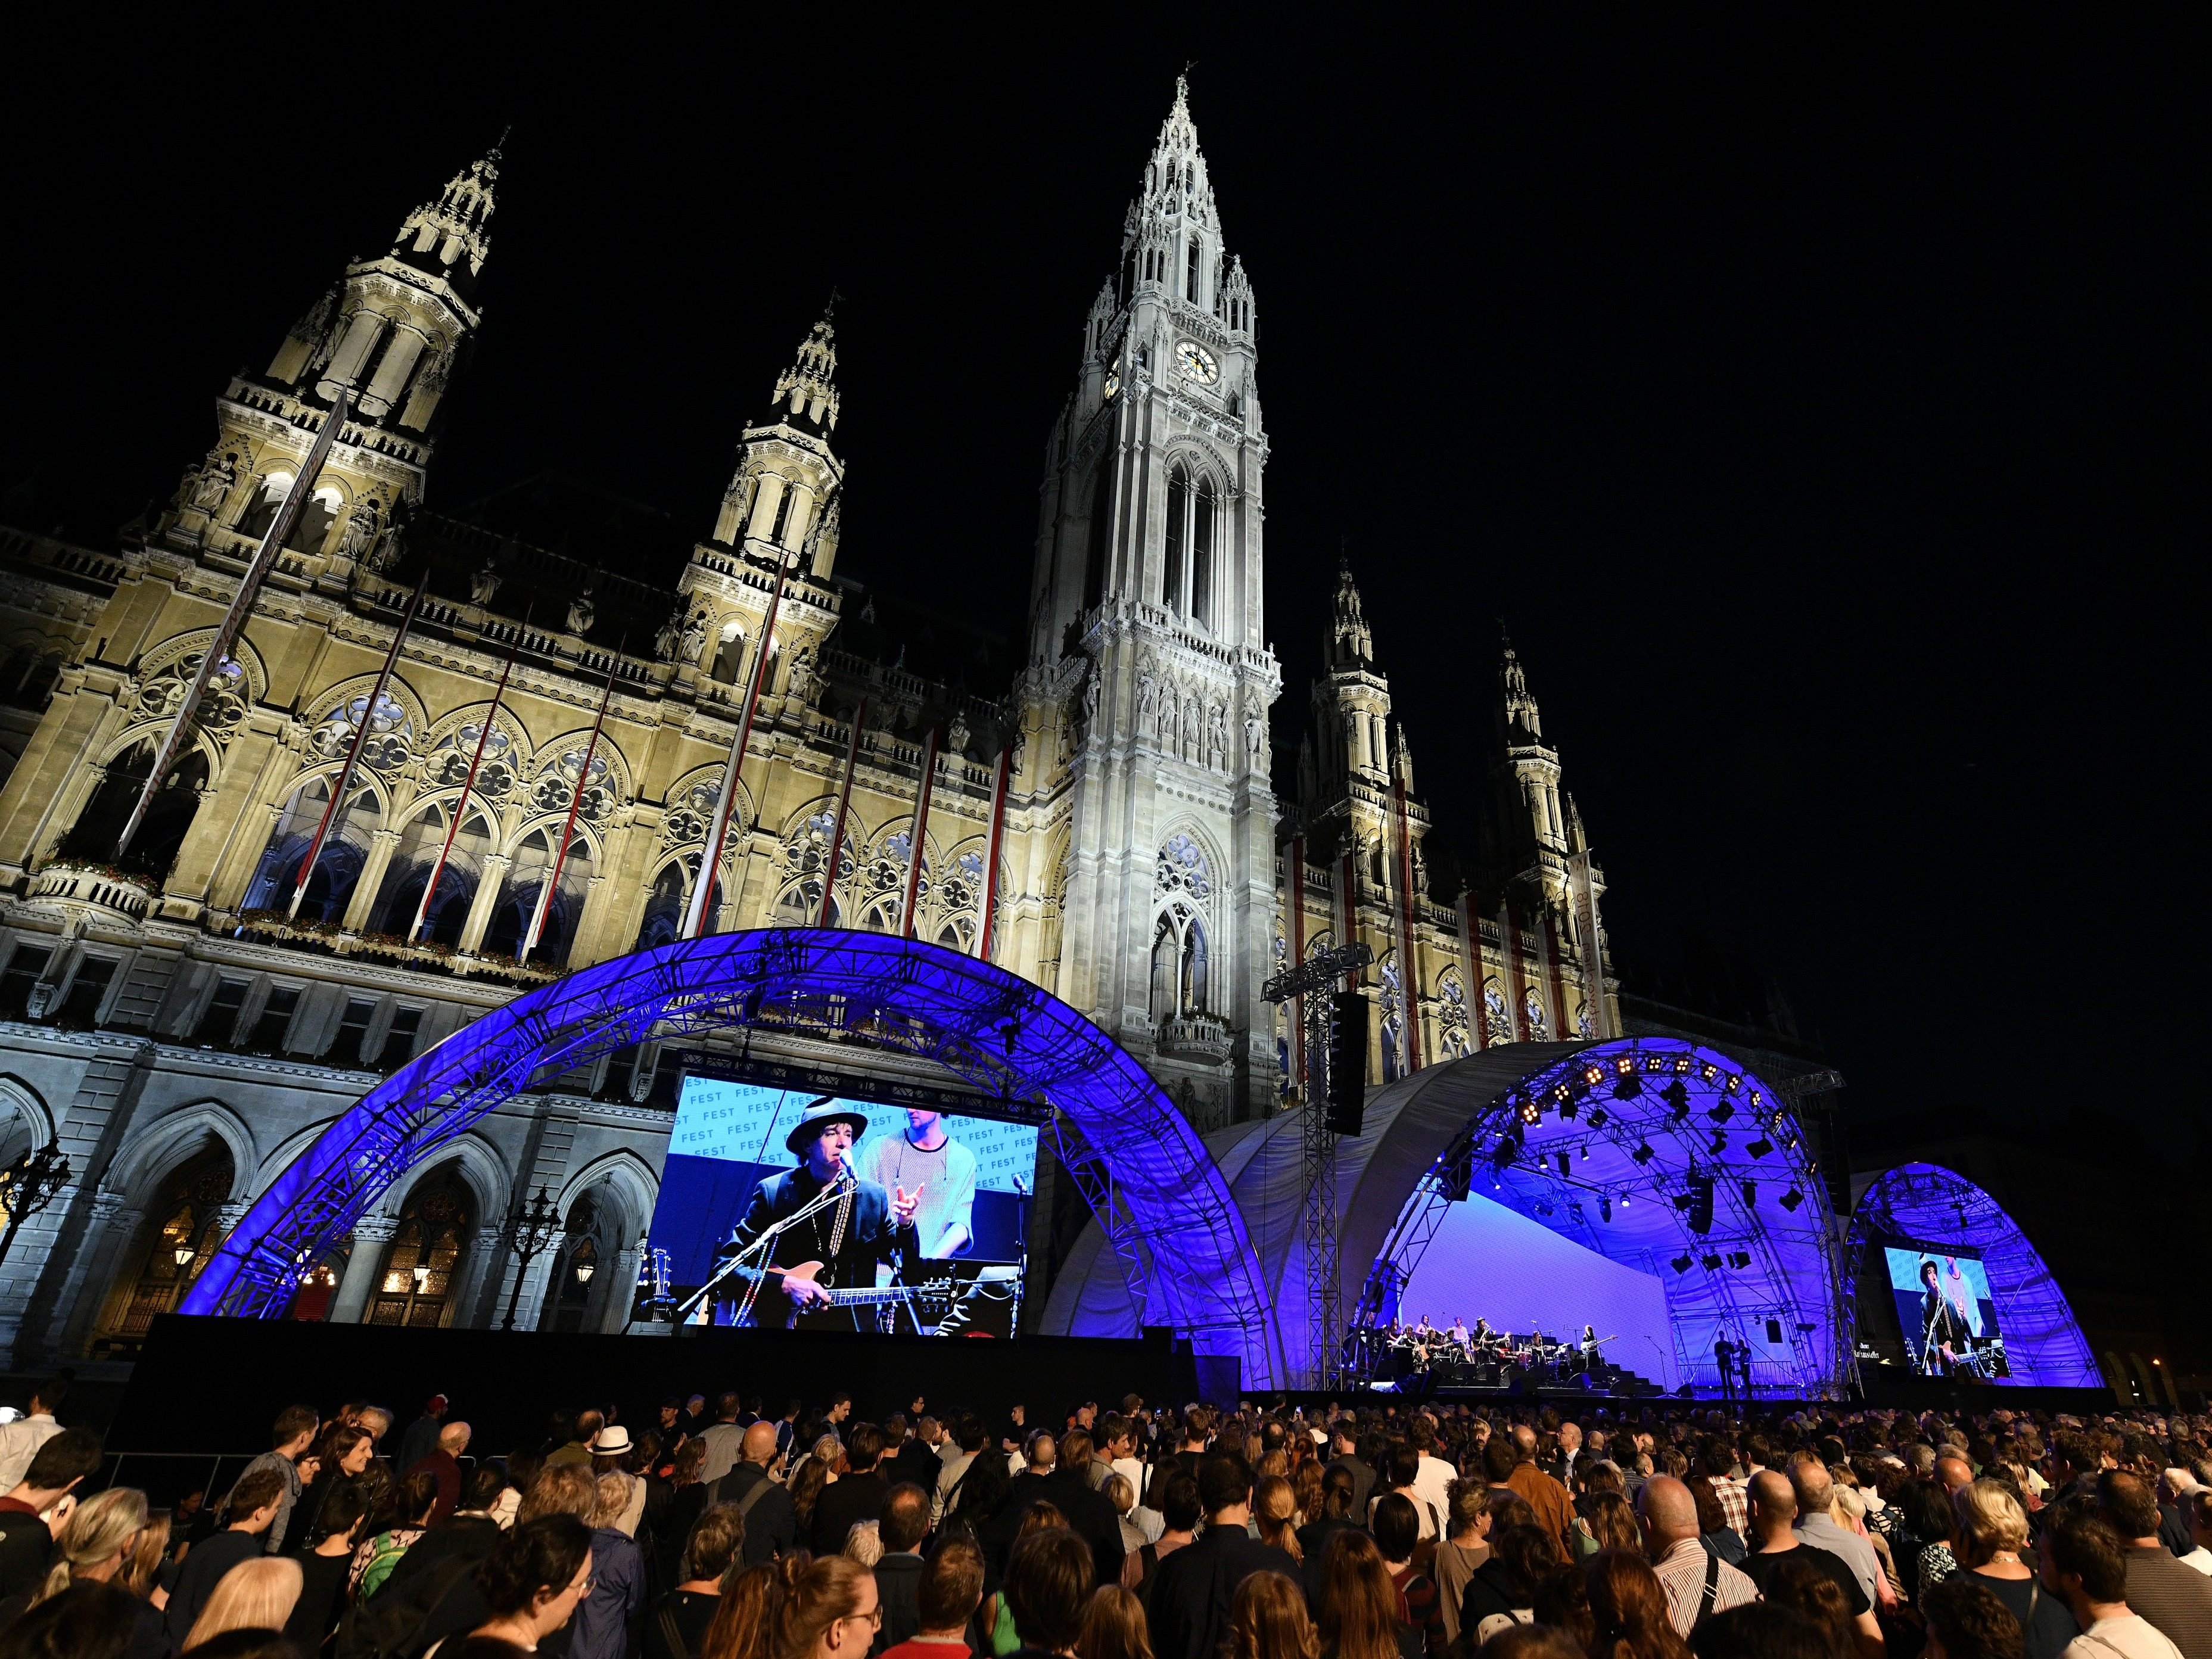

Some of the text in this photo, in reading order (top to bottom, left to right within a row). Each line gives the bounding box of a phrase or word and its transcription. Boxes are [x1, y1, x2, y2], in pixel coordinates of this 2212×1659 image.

[690, 1092, 721, 1104] FEST
[704, 1108, 734, 1120] FEST
[748, 1101, 777, 1113] FEST
[868, 1116, 891, 1126] EST
[682, 1129, 713, 1143] FEST
[727, 1122, 758, 1135] FEST
[774, 1115, 801, 1126] EST
[969, 1129, 993, 1141] FEST
[980, 1143, 1004, 1155] FEST
[991, 1157, 1016, 1169] FEST
[976, 1176, 1001, 1187] FEST
